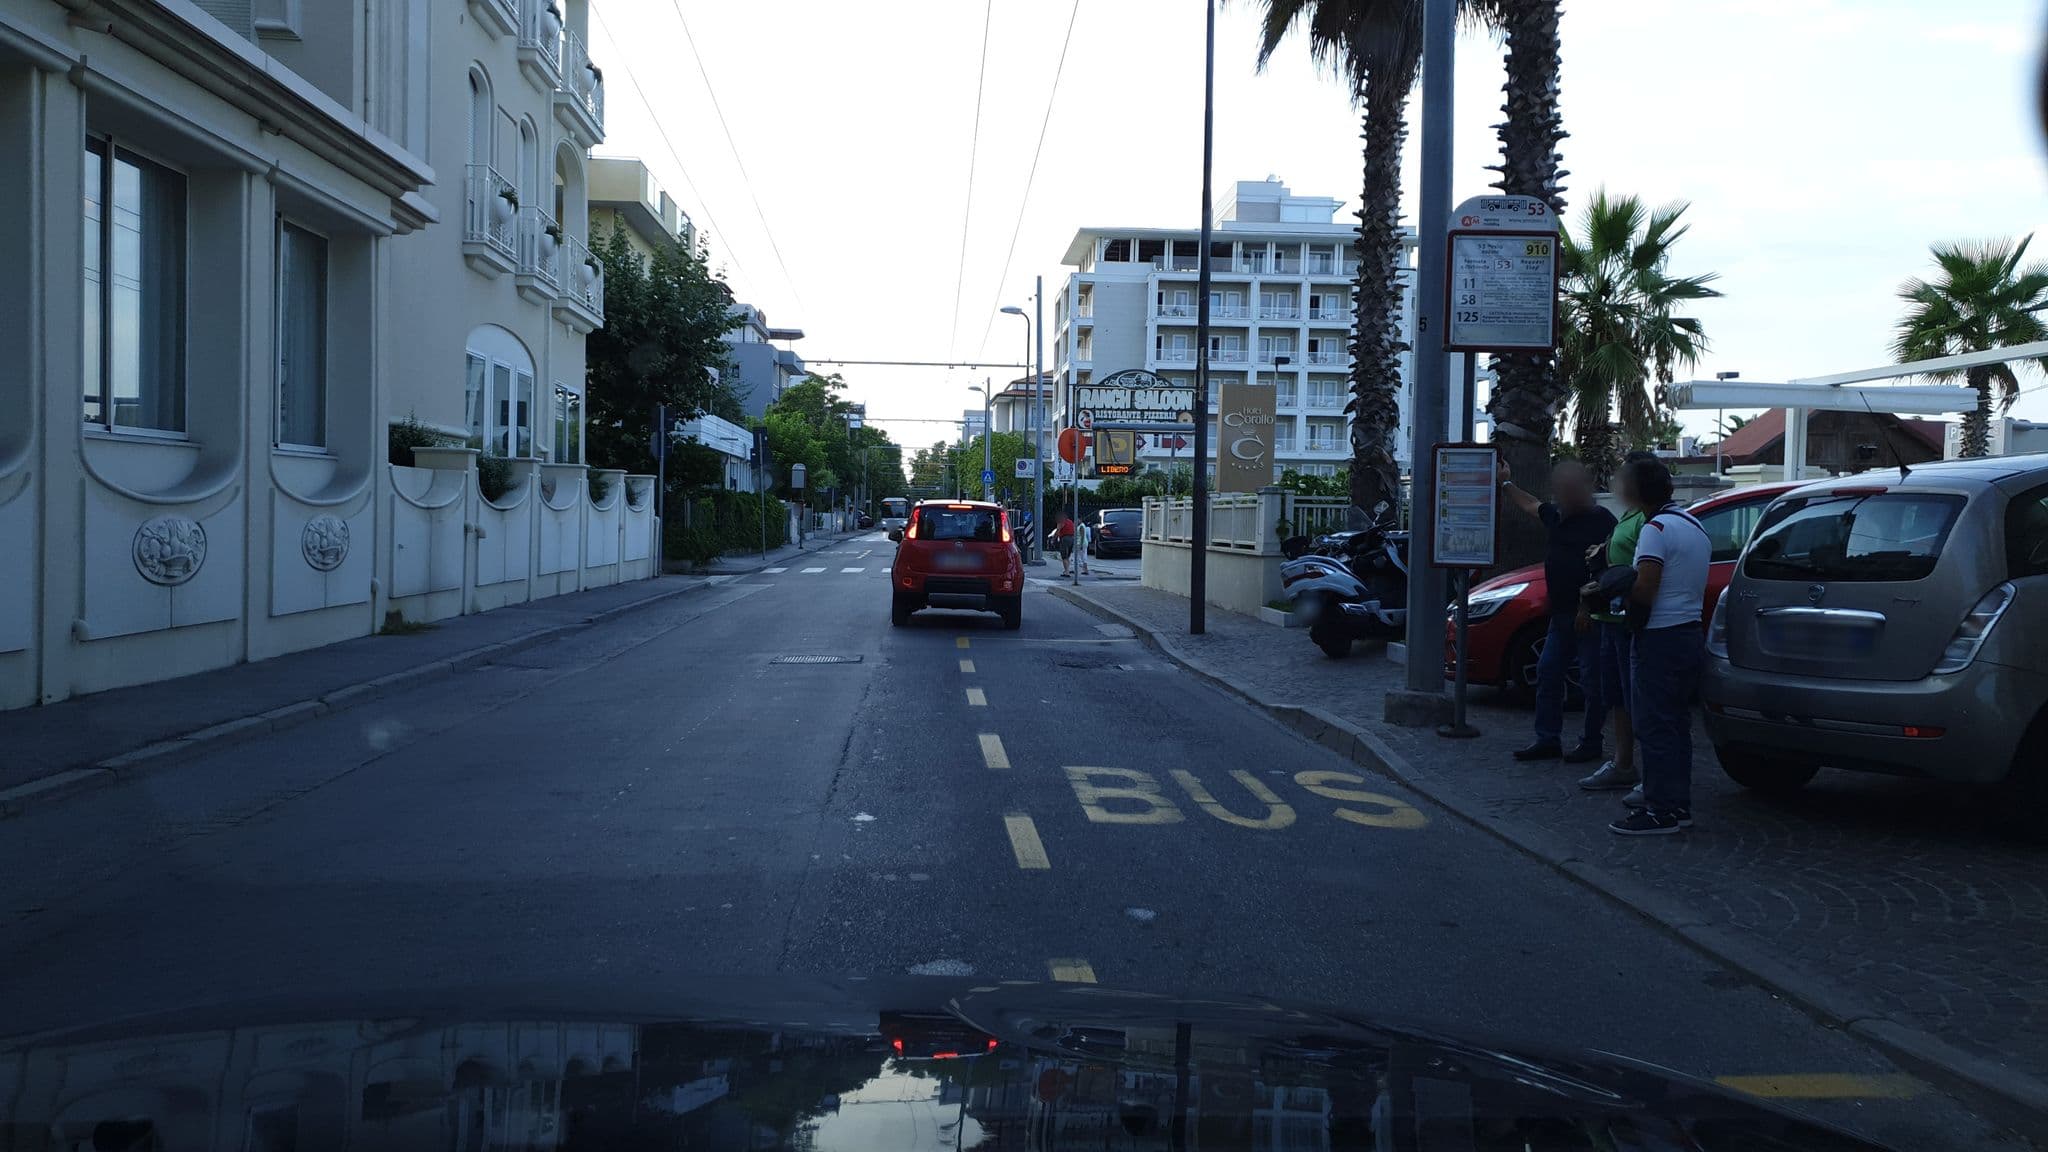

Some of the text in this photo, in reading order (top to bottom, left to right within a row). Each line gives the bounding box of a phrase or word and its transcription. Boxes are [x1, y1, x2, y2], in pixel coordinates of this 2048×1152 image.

[1527, 202, 1546, 216] 53
[1526, 244, 1549, 256] 910
[1496, 260, 1511, 269] 53
[1463, 277, 1476, 289] 11
[1460, 294, 1477, 305] 58
[1456, 311, 1479, 323] 125
[1079, 389, 1193, 411] RANCH SALOON
[1095, 410, 1177, 420] RISTORANTE PIZZERIA
[1101, 465, 1129, 473] LIBERO
[1061, 765, 1431, 830] BUS
